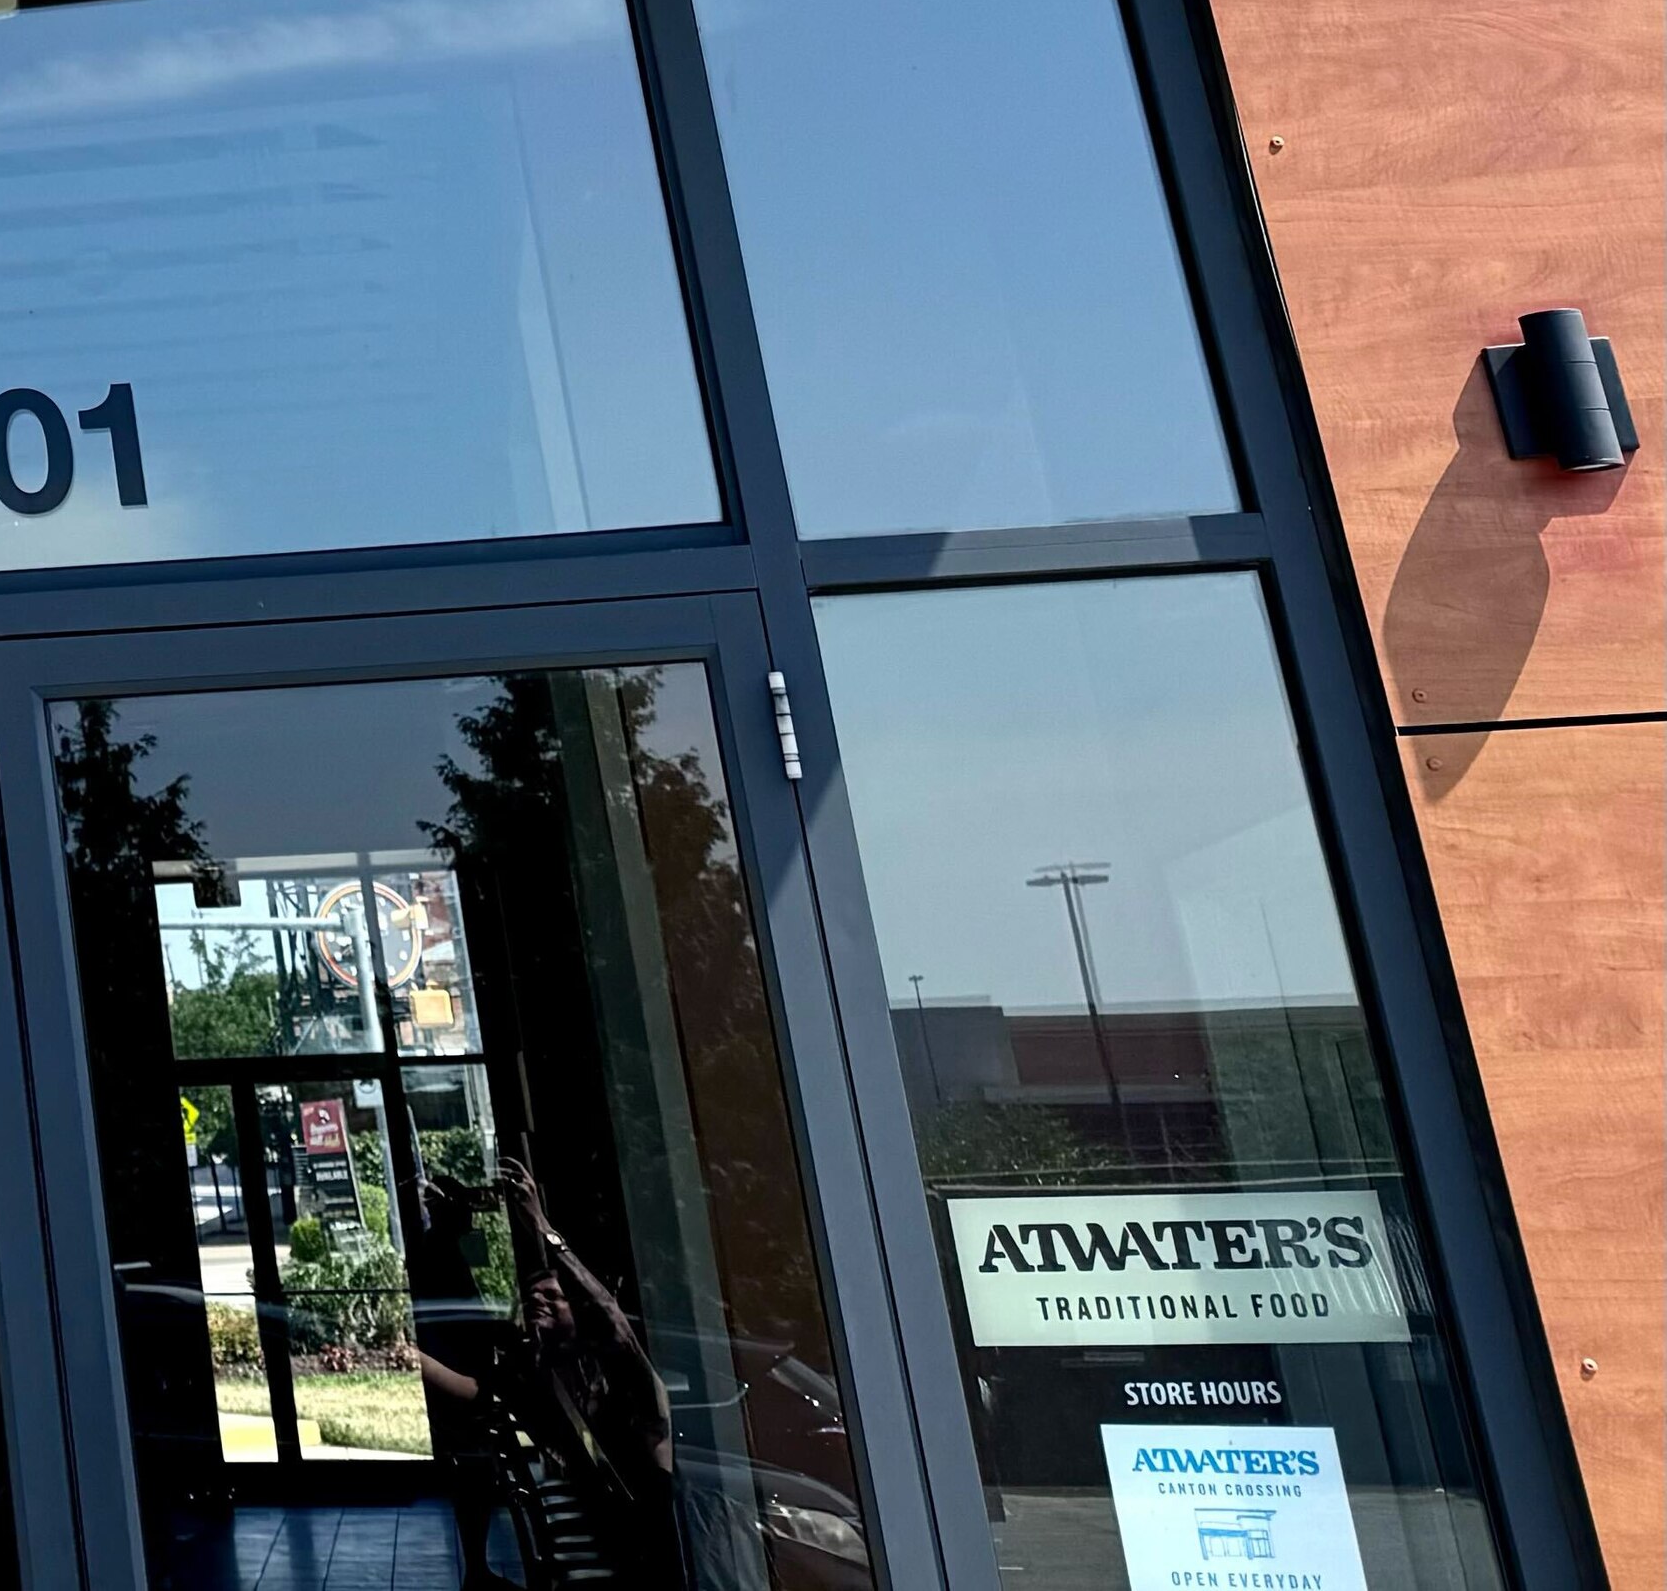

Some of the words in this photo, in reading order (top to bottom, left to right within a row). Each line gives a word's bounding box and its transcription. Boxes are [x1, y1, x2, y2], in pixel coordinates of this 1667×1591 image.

[978, 1215, 1373, 1273] ATWATER'S
[1036, 1294, 1238, 1321] TRADITIONAL
[1252, 1293, 1329, 1318] FOOD
[1124, 1382, 1198, 1406] STORE
[1201, 1380, 1283, 1405] HOURS
[1132, 1447, 1320, 1476] ATWATER'S
[1158, 1482, 1218, 1496] CANTON
[1225, 1484, 1303, 1498] CROSSING
[1171, 1571, 1218, 1587] OPEN
[1228, 1572, 1323, 1591] EVERYDAY
